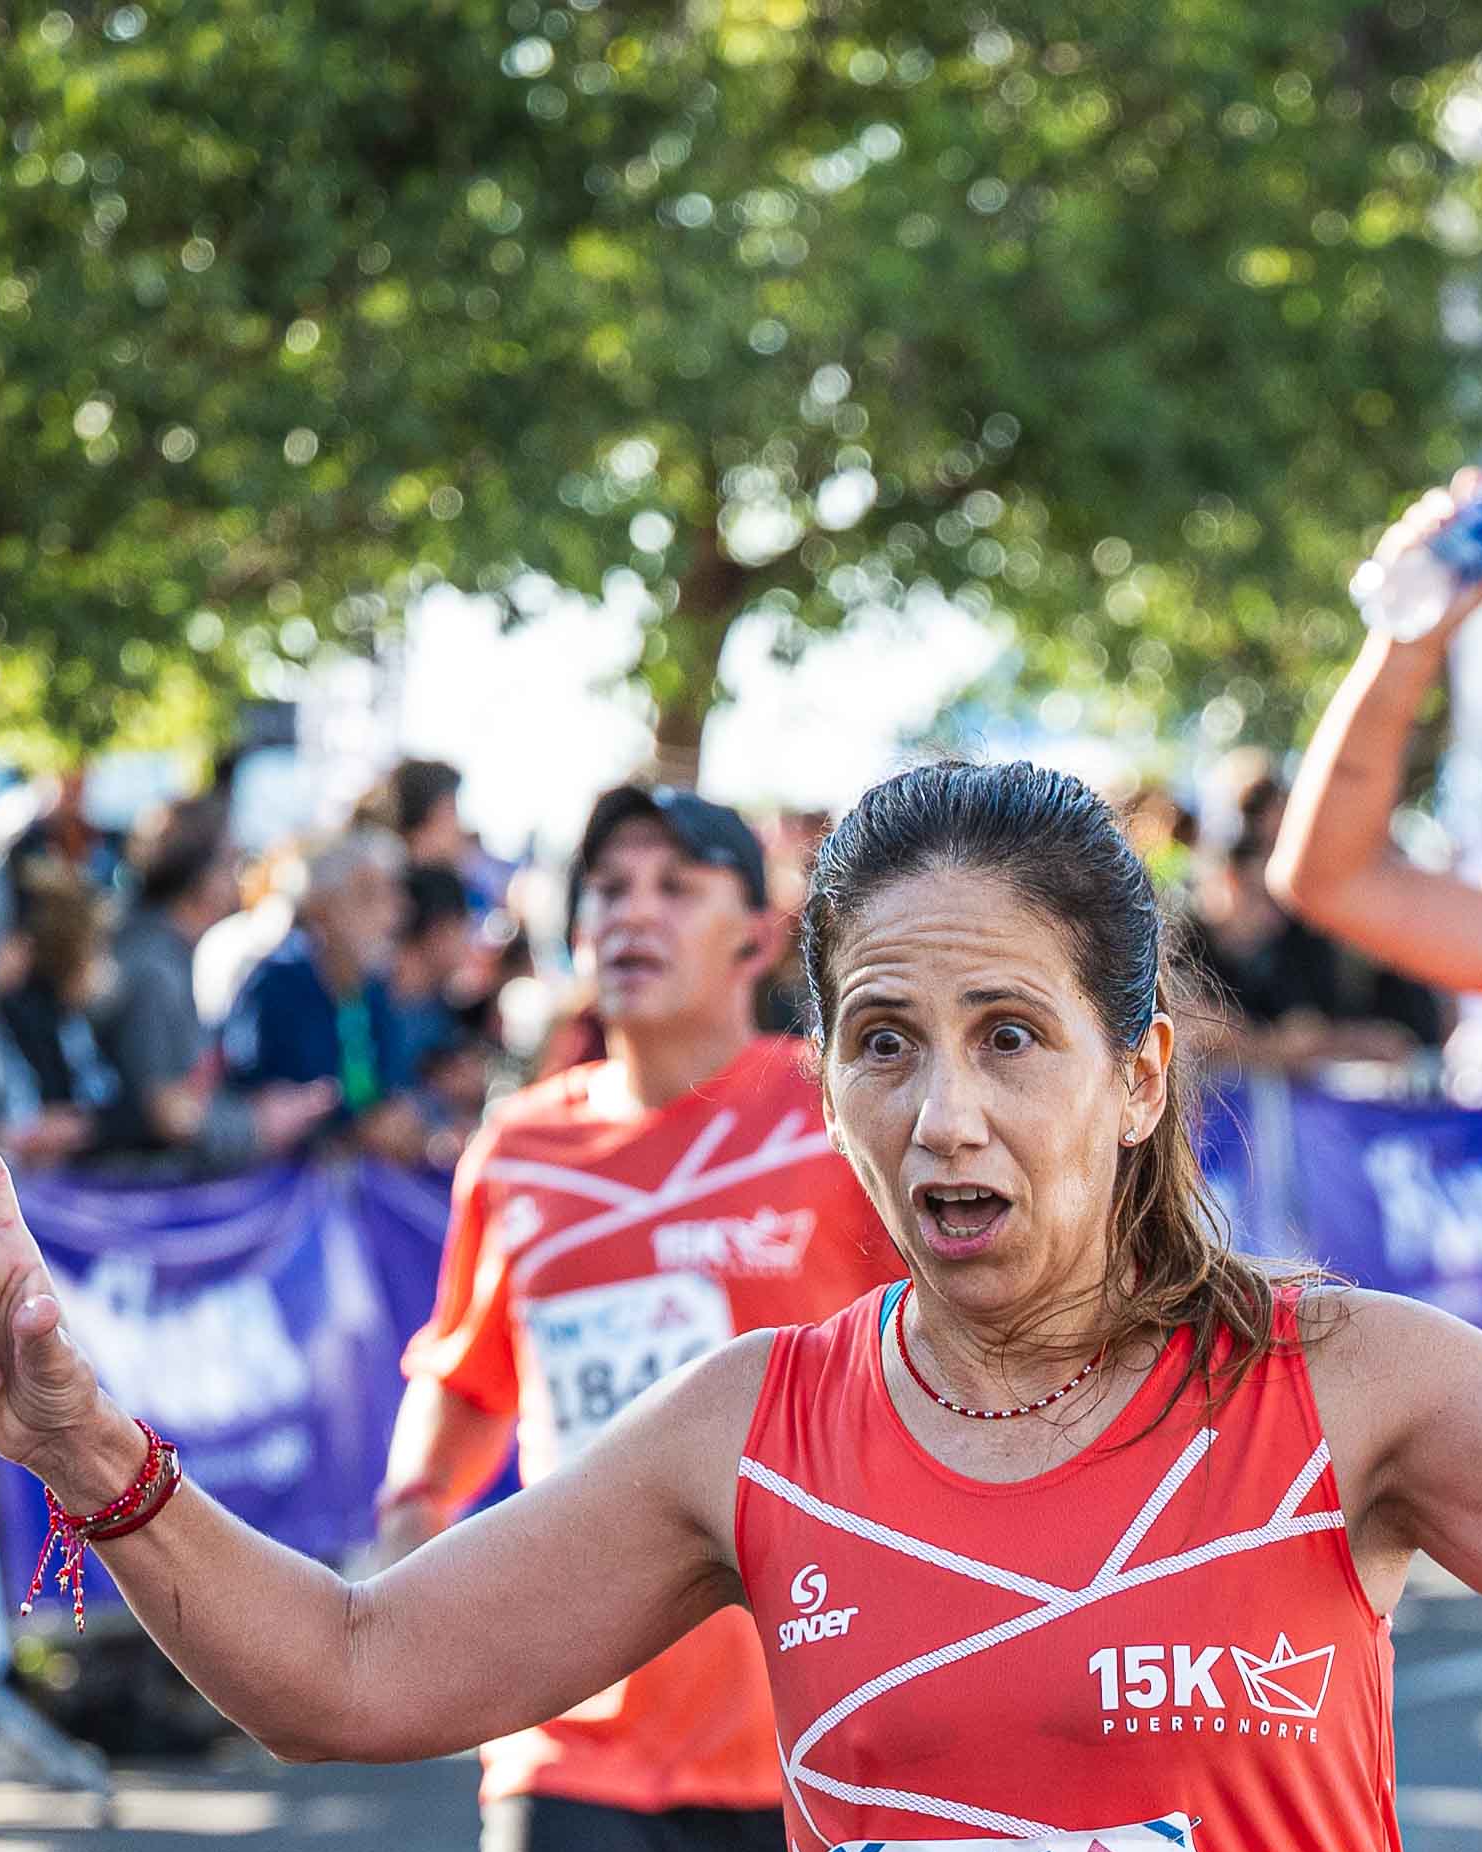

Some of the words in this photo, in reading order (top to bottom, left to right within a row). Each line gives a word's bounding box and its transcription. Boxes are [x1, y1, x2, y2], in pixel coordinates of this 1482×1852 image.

[1089, 1645, 1226, 1710] 15K
[1103, 1716, 1225, 1735] PUERTO
[1238, 1719, 1317, 1743] NORTE
